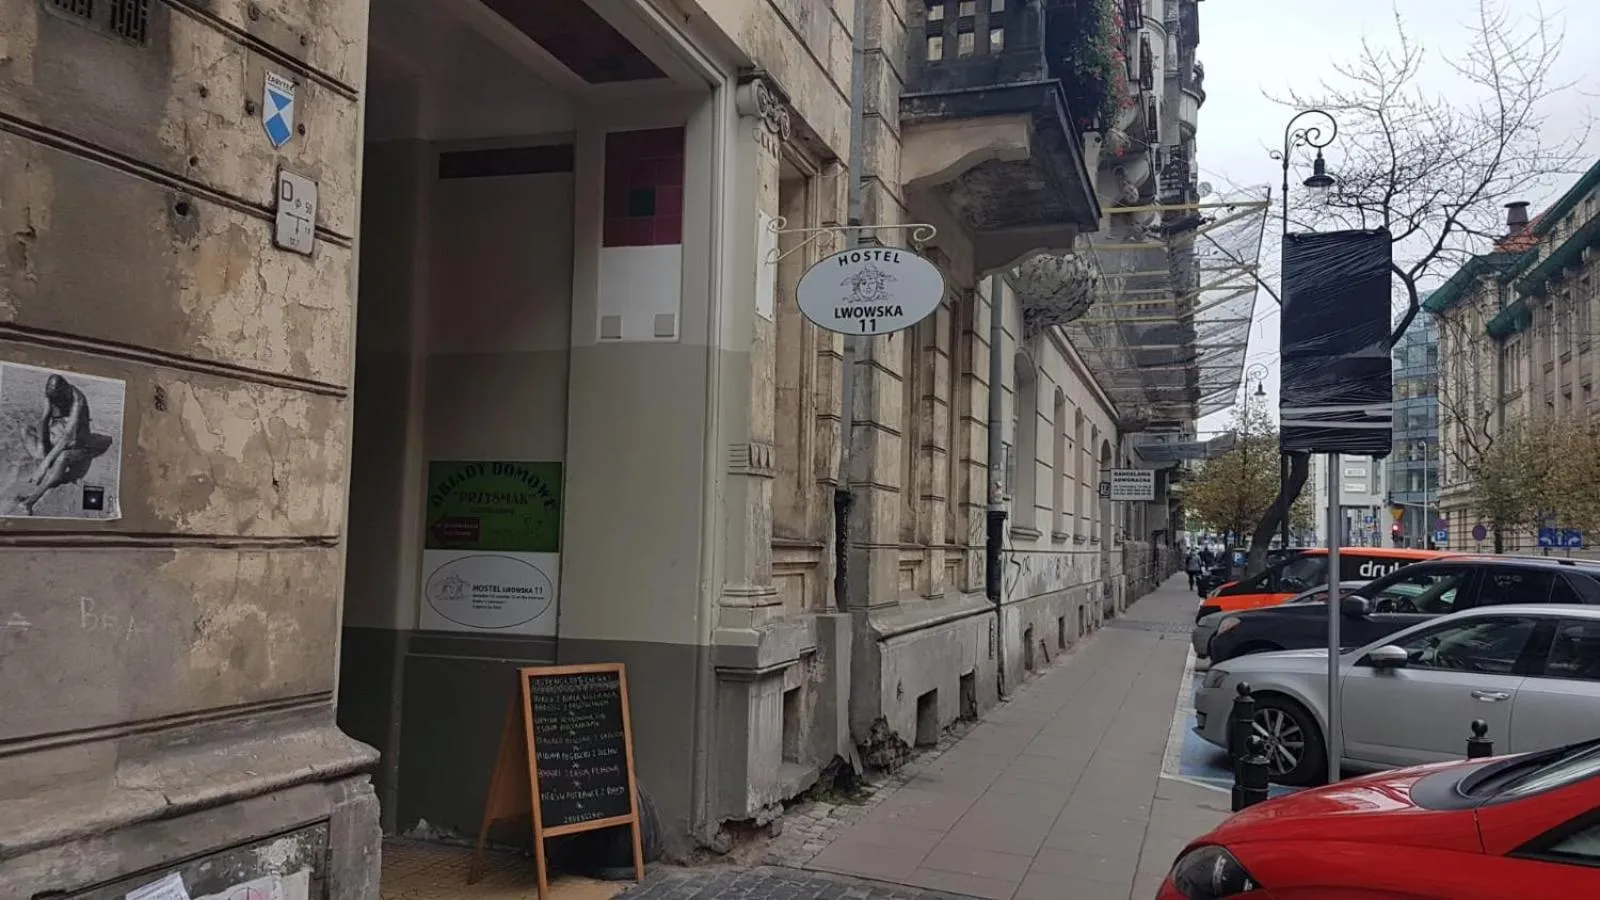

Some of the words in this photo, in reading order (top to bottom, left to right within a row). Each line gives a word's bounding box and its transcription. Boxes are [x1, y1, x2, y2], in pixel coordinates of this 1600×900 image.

[281, 179, 293, 202] D
[838, 250, 901, 267] HOSTEL
[834, 305, 904, 319] LWOWSKA
[859, 319, 877, 332] 11
[432, 464, 488, 507] OBIADY
[491, 462, 557, 509] DOMOWE
[472, 584, 501, 593] HOSTEL
[502, 586, 533, 594] LWOWSKA
[534, 586, 543, 594] 11
